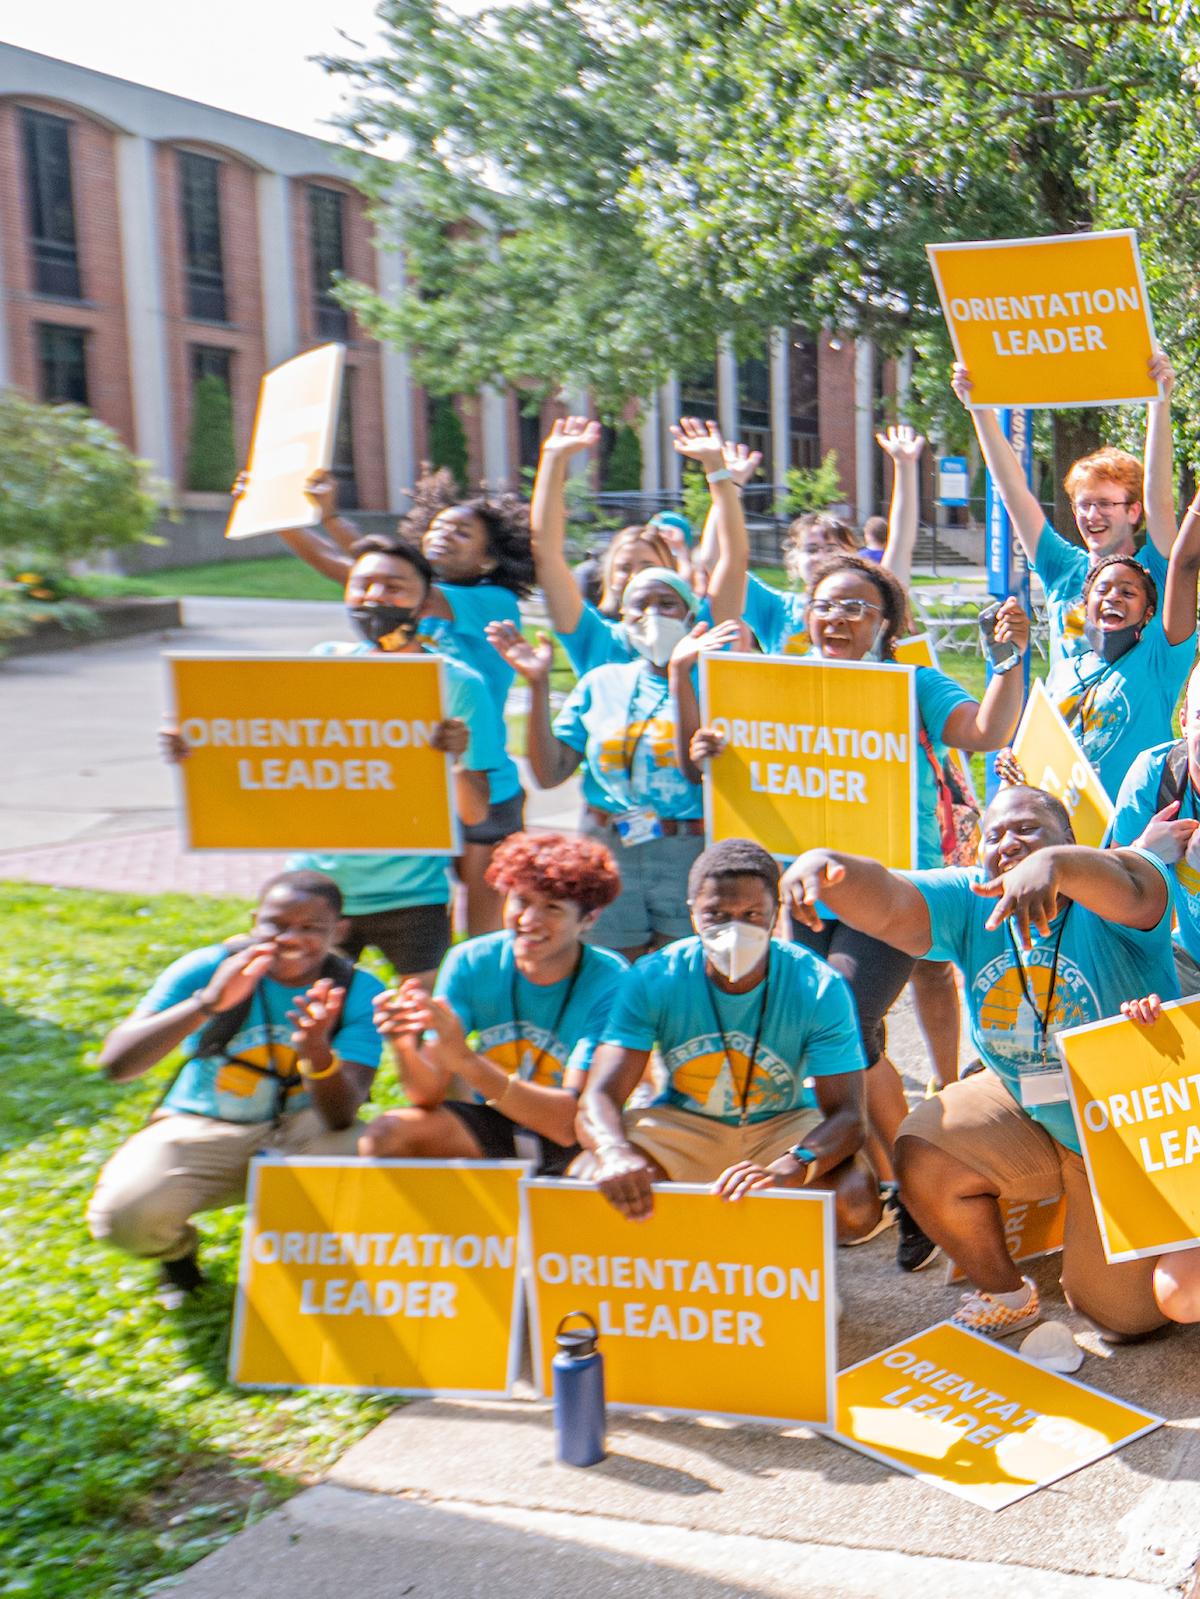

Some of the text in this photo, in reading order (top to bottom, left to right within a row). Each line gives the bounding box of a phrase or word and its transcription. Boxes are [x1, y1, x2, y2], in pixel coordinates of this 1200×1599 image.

[952, 287, 1140, 321] ORIENTATION
[992, 325, 1107, 356] LEADER
[711, 717, 907, 763] ORIENTATION
[238, 758, 395, 790] LEADER
[750, 761, 868, 804] LEADER
[253, 1231, 514, 1269] ORIENTATION
[538, 1252, 820, 1301] ORIENTATION
[299, 1278, 457, 1318] LEADER
[598, 1301, 765, 1347] LEADER
